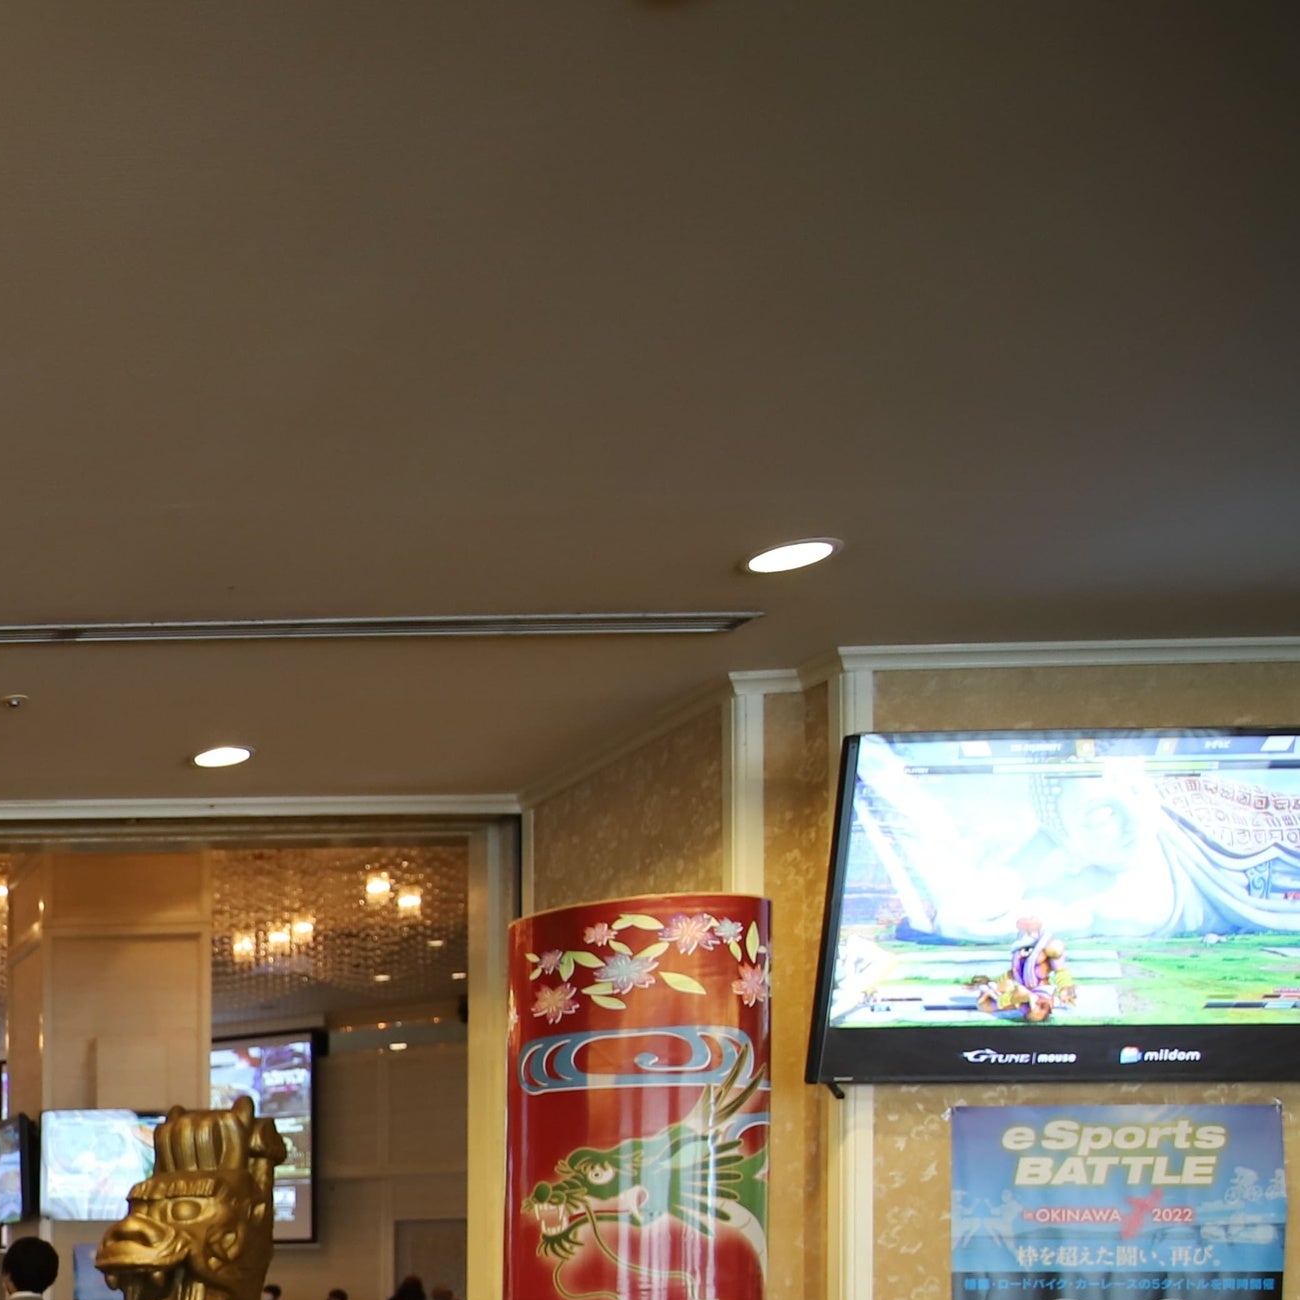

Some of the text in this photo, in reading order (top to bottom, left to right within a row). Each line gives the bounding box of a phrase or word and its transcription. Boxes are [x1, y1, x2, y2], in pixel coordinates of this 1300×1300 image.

[1037, 1053, 1077, 1064] mouse
[1144, 1049, 1201, 1061] mildom
[1014, 1156, 1218, 1185] BATTLE
[1036, 1209, 1122, 1222] OKINAWA
[1152, 1208, 1193, 1222] 2022
[1016, 1245, 1222, 1267] 枠を超えた闘い、再び。
